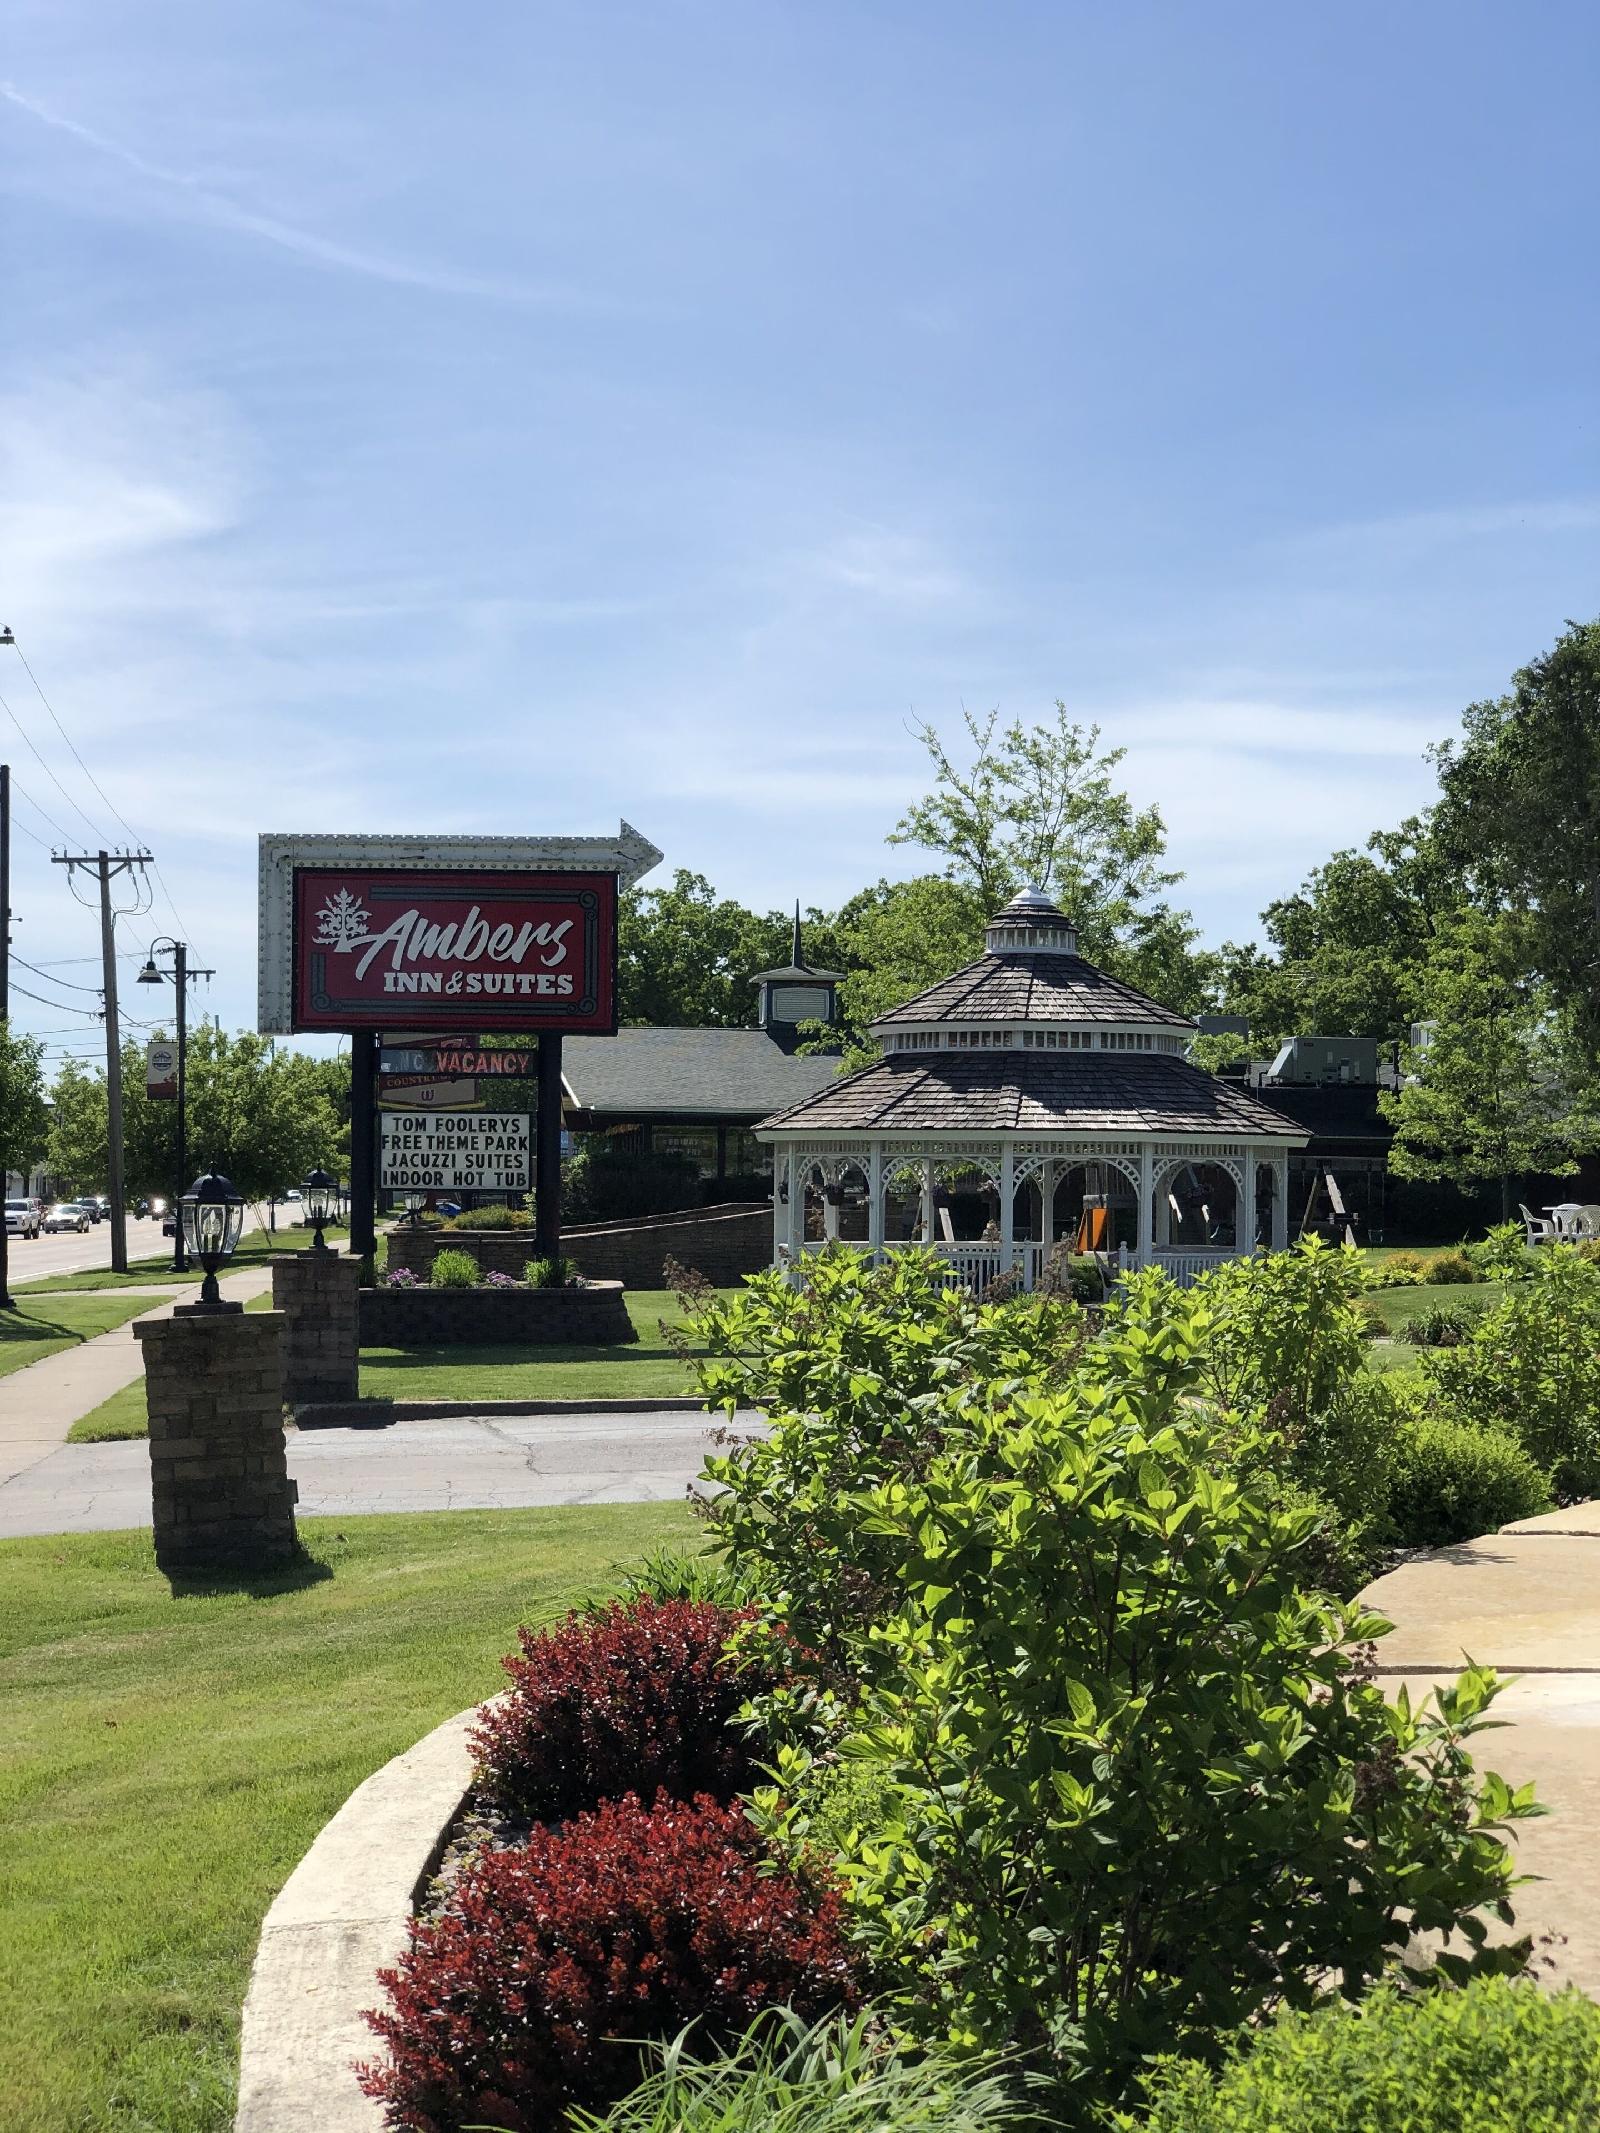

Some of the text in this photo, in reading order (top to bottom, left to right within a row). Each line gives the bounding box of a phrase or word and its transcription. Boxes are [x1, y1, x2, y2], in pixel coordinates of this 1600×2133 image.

[354, 905, 574, 981] Ambers
[383, 972, 443, 993] INN
[466, 973, 573, 995] SUITES
[436, 1050, 530, 1074] VACANCY
[393, 1117, 520, 1133] TOM FOOLERYS
[382, 1134, 528, 1151] FREE THEME PARK
[387, 1152, 524, 1169] JACUZZI SUITES
[383, 1170, 527, 1187] INDOOR HOT TUB
